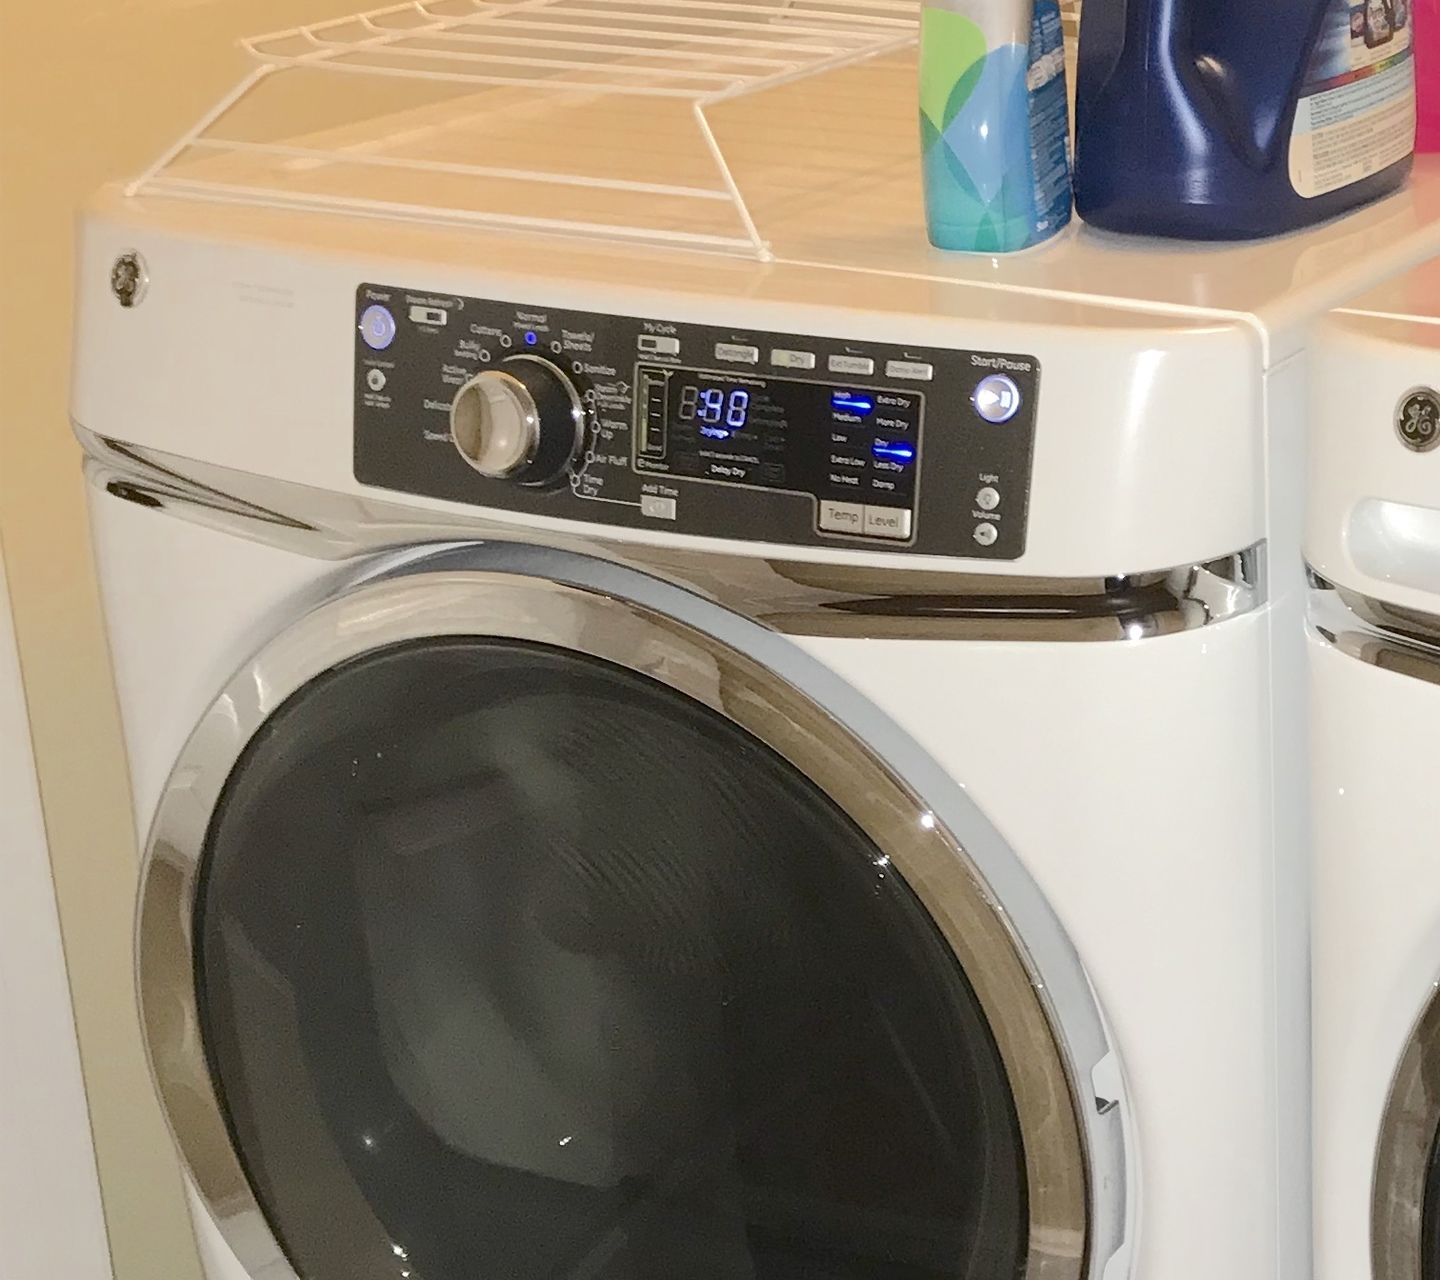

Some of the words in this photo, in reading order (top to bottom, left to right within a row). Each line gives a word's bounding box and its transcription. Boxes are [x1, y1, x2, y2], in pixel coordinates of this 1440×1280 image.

[971, 355, 1031, 372] Start/Pause
[877, 395, 897, 404] Extra
[898, 398, 911, 408] Dry
[876, 418, 894, 428] More
[895, 420, 909, 431] Dry
[832, 434, 848, 443] Low
[711, 464, 731, 476] Delay
[732, 467, 745, 477] Dry
[583, 474, 603, 486] Time
[979, 473, 999, 483] Light
[583, 484, 598, 496] Dry
[872, 479, 895, 491] Damp
[829, 508, 859, 523] Temp
[972, 509, 1001, 520] Volume
[869, 514, 899, 528] Level
